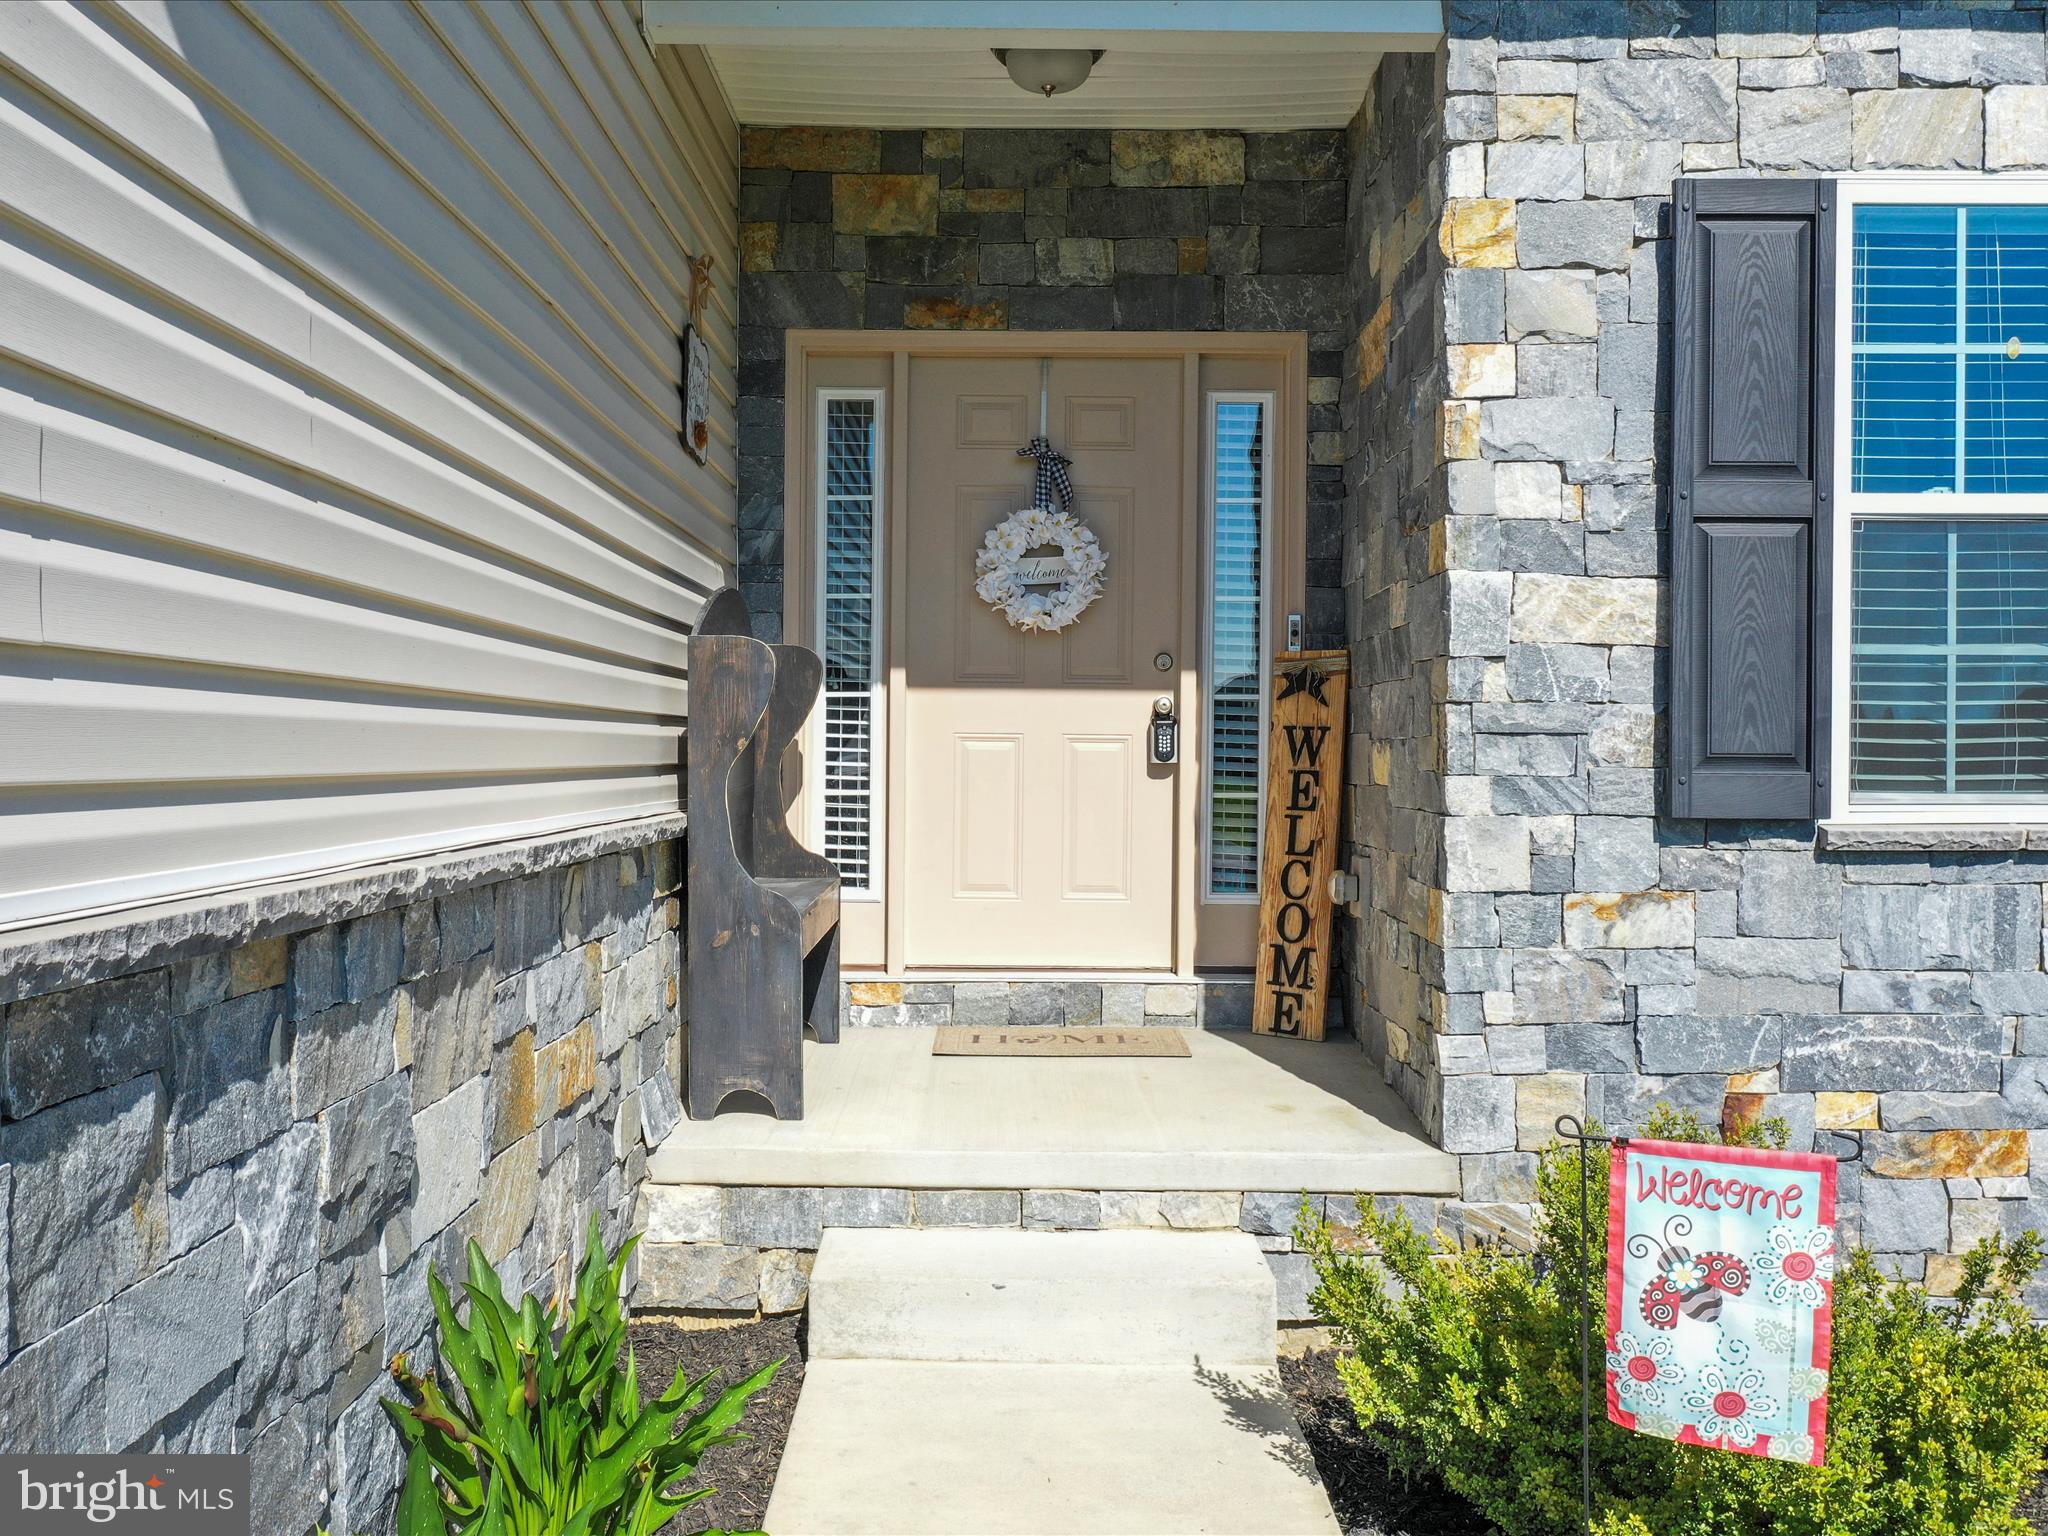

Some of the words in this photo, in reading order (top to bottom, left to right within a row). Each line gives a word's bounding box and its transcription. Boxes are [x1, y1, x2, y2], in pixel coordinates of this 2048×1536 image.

[1016, 559, 1069, 580] welcome
[1266, 725, 1331, 1036] WELCOME
[1636, 1161, 1803, 1220] Welcome
